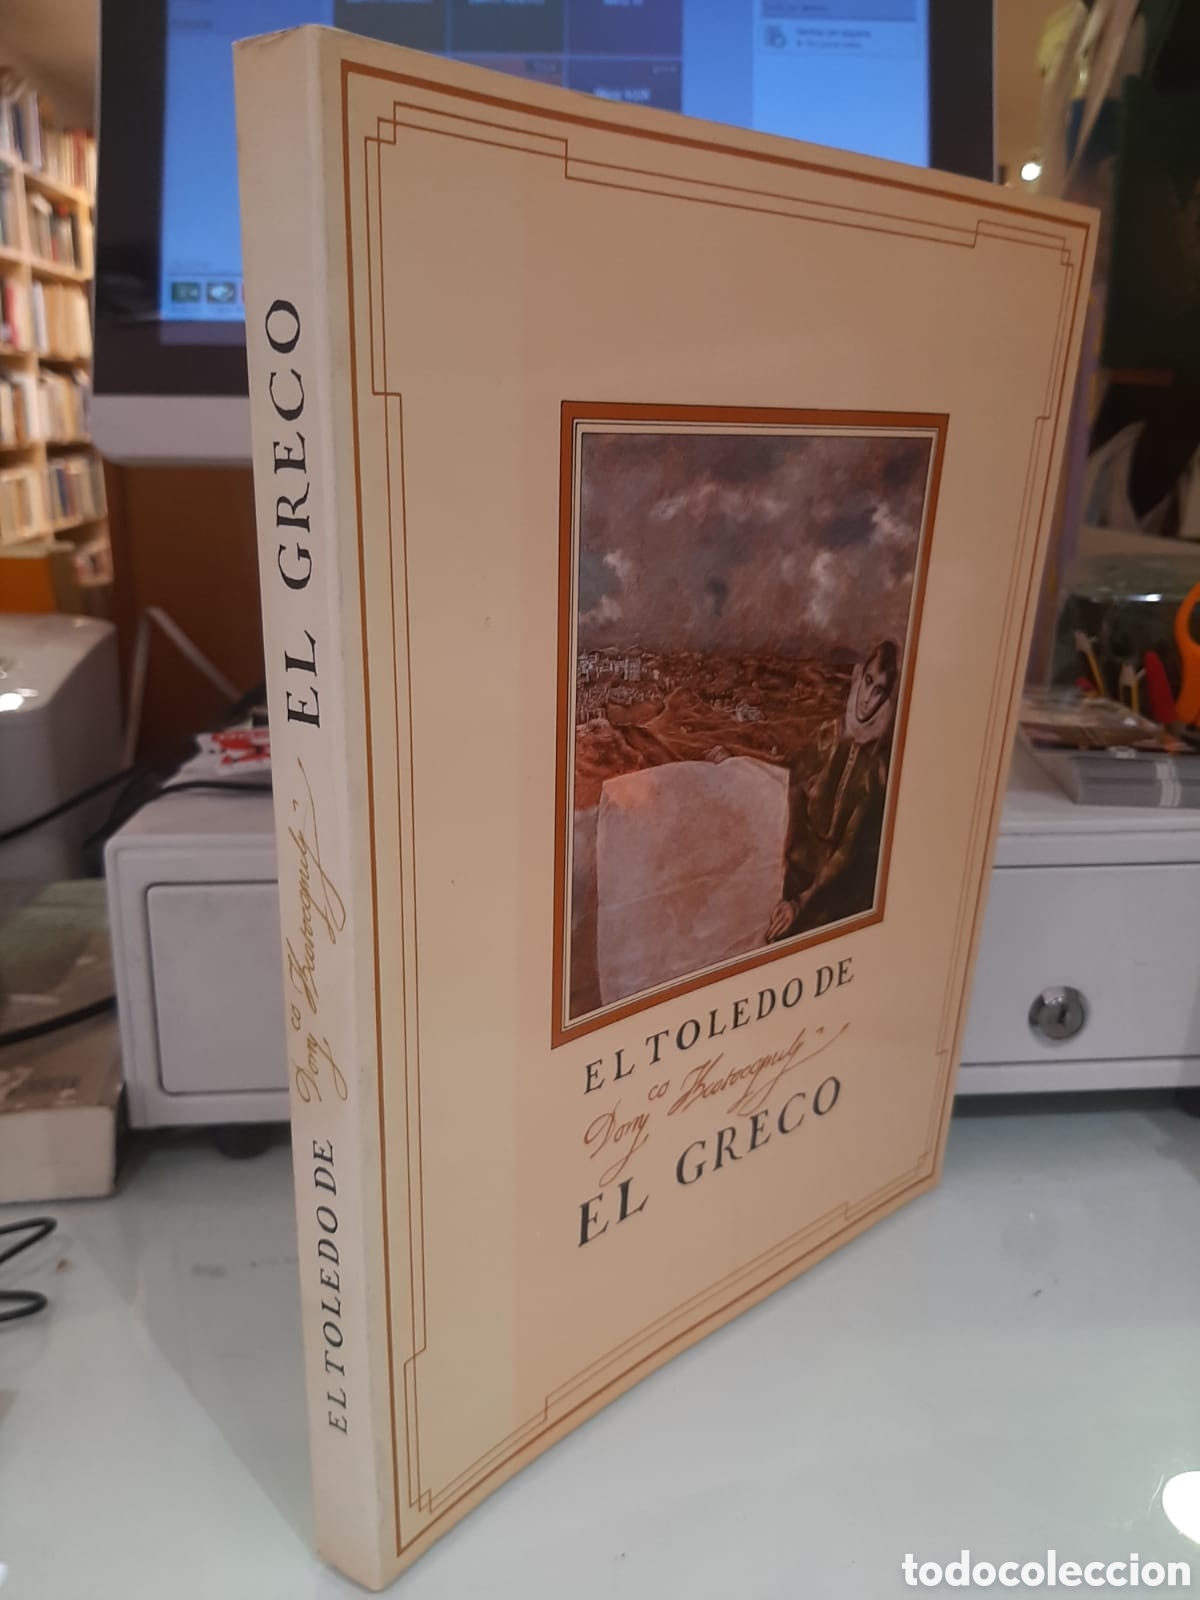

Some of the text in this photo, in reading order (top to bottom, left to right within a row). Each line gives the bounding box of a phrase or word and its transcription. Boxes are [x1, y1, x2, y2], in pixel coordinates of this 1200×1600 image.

[265, 299, 321, 728] EL GRECO
[584, 957, 855, 1095] EL TOLEDO DE
[578, 1075, 841, 1248] EL GRECO
[312, 1139, 348, 1436] EL TOLEDO DE
